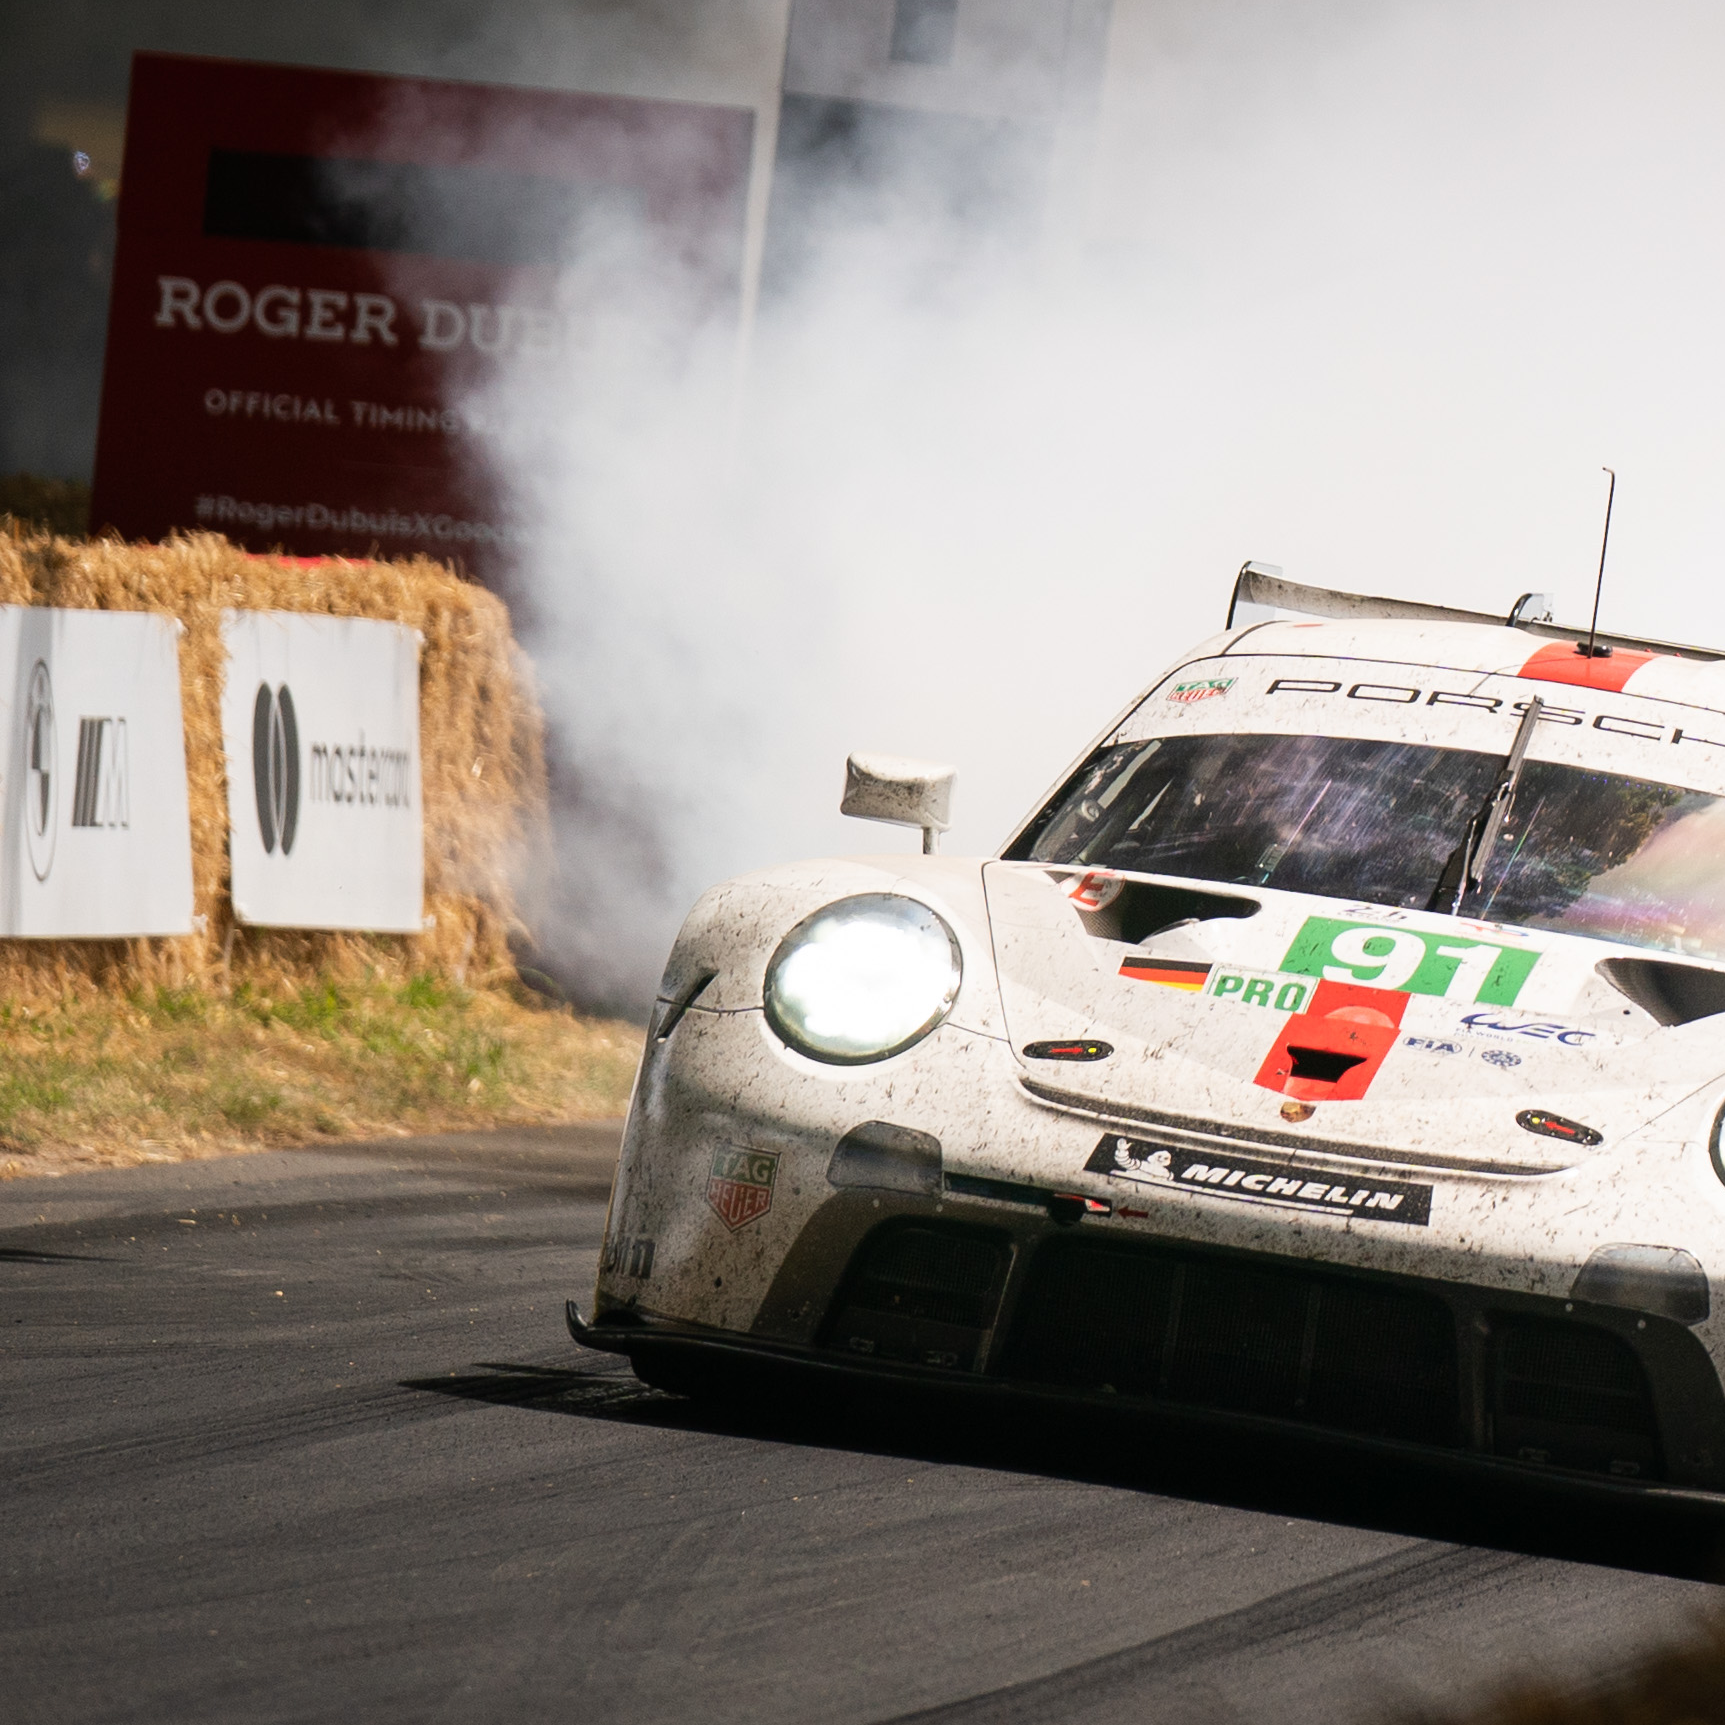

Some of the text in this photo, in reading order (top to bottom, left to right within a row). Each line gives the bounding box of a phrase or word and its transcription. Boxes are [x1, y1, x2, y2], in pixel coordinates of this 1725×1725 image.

[155, 275, 602, 359] ROGER DUBU
[204, 387, 341, 426] OFFICIAL
[350, 399, 459, 434] TIMING
[310, 729, 410, 809] master
[1322, 926, 1503, 1005] 91
[1213, 974, 1309, 1013] PRO
[1407, 1037, 1456, 1053] FIA
[1460, 1013, 1596, 1046] WEC
[719, 1152, 772, 1184] TAG
[1181, 1163, 1404, 1211] MICHELIN
[712, 1181, 768, 1224] HEUER
